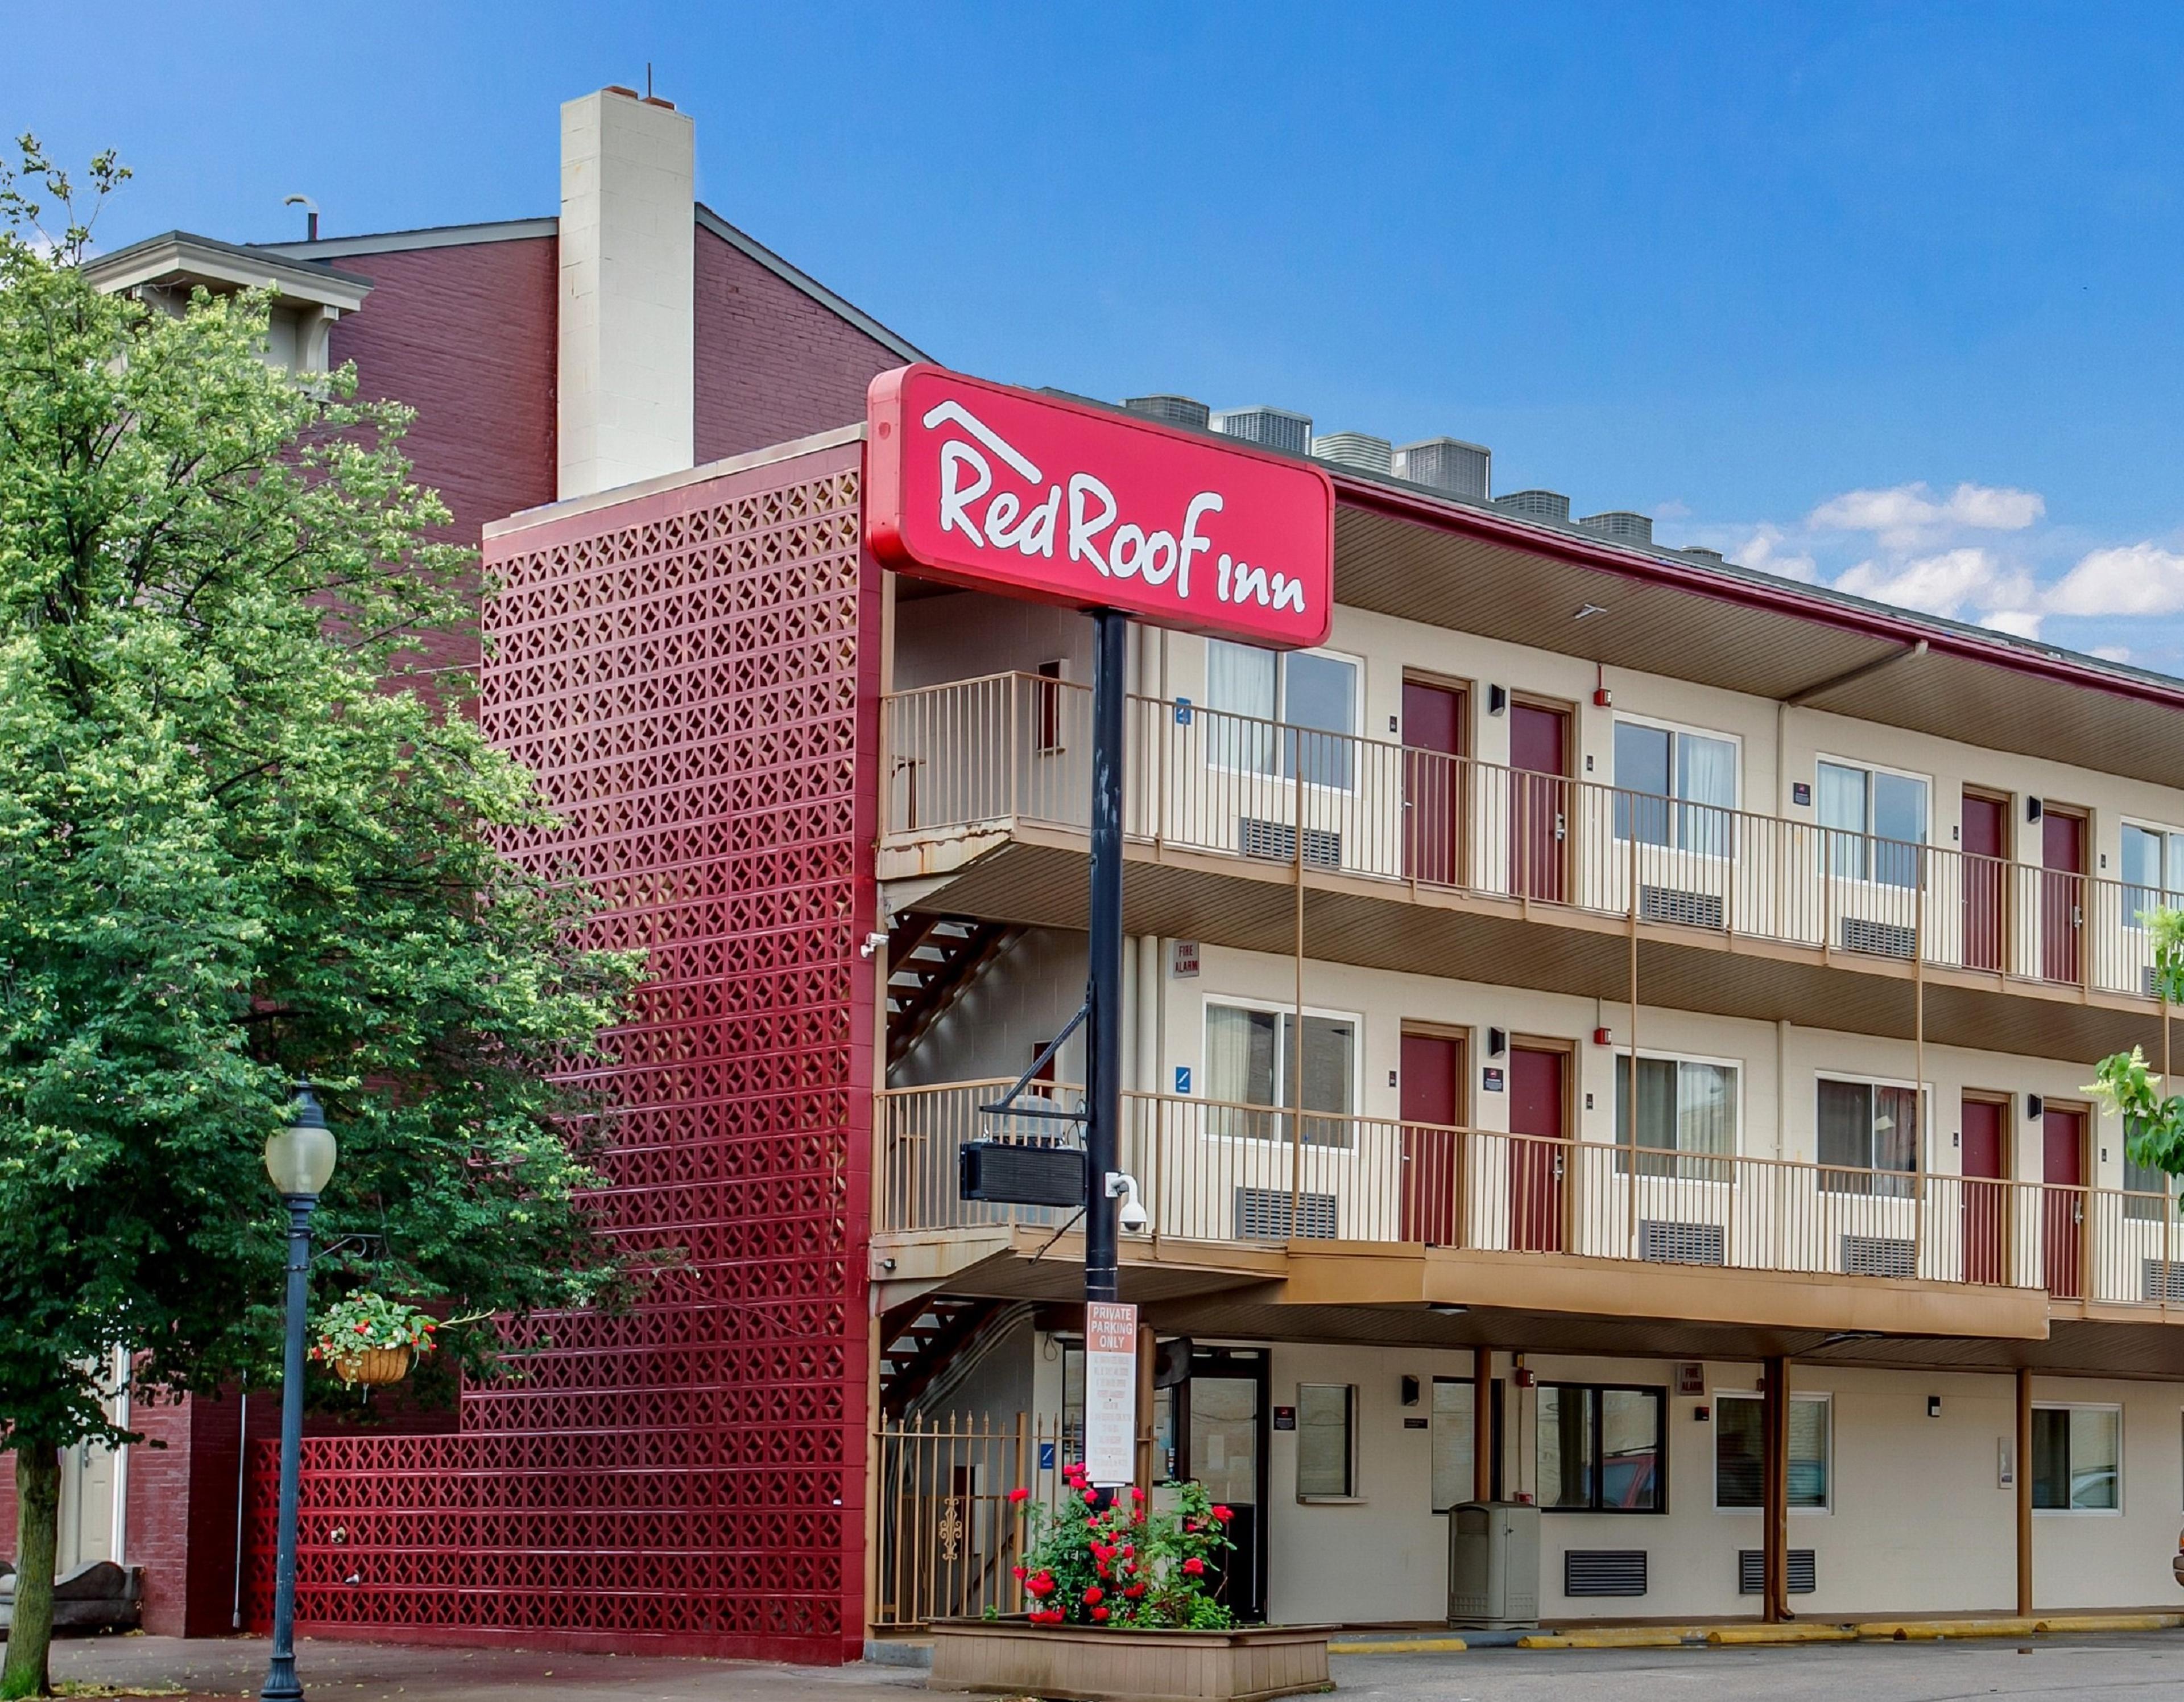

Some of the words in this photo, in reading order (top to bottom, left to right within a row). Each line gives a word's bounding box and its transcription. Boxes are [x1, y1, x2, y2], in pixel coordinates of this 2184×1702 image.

[940, 440, 1062, 558] Red
[1068, 473, 1223, 599] Roof
[1179, 945, 1193, 957] FIRE
[1176, 960, 1198, 972] ALARM
[1093, 1307, 1131, 1320] PRIVATE
[1091, 1320, 1133, 1335] PARKING
[1099, 1335, 1124, 1348] ONLY
